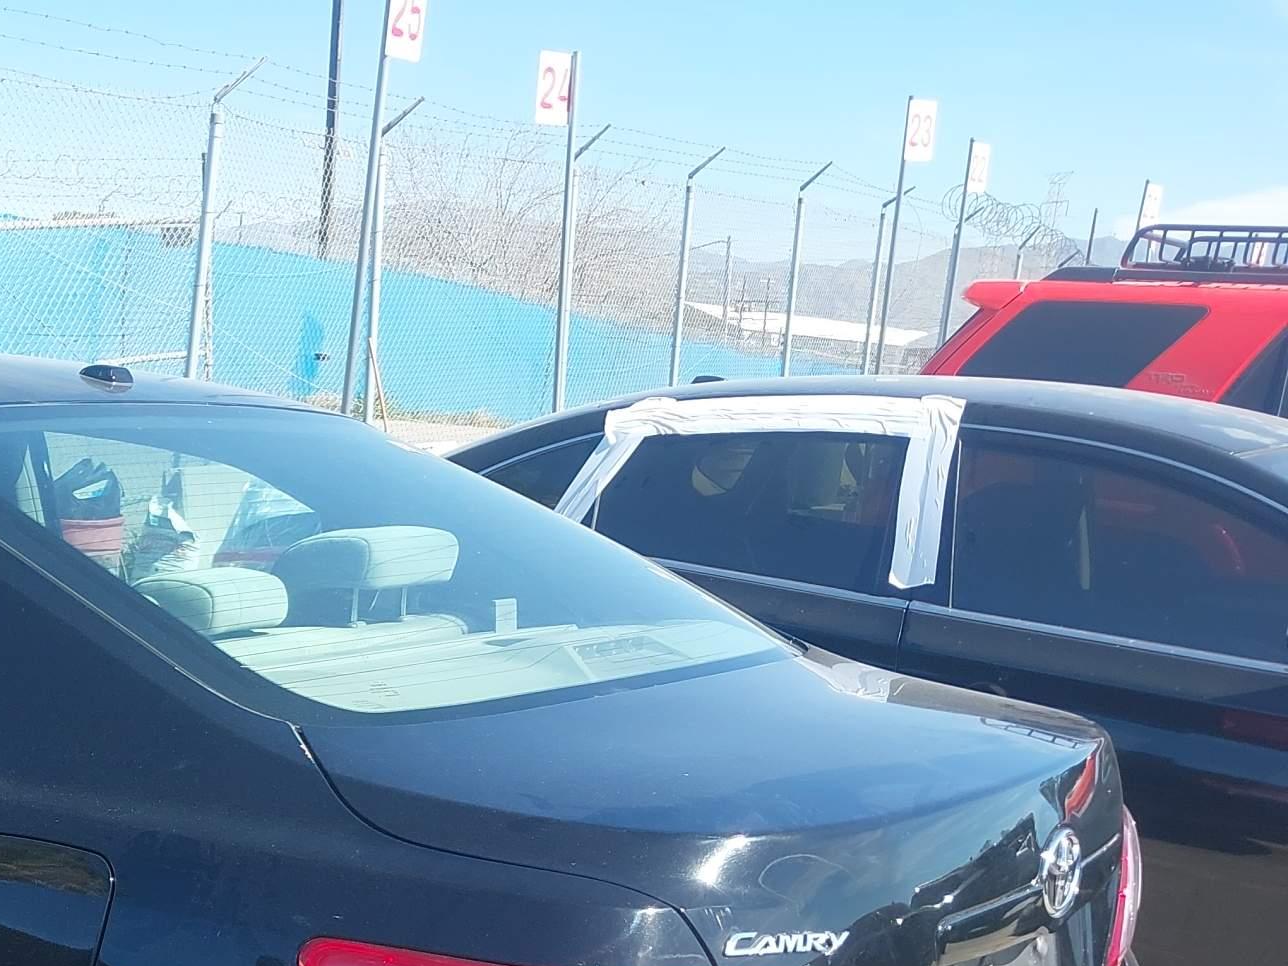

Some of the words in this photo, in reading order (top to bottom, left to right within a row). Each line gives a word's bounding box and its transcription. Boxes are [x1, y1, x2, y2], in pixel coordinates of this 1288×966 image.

[392, 0, 421, 41] 25
[540, 66, 572, 112] 24
[909, 113, 932, 148] 23
